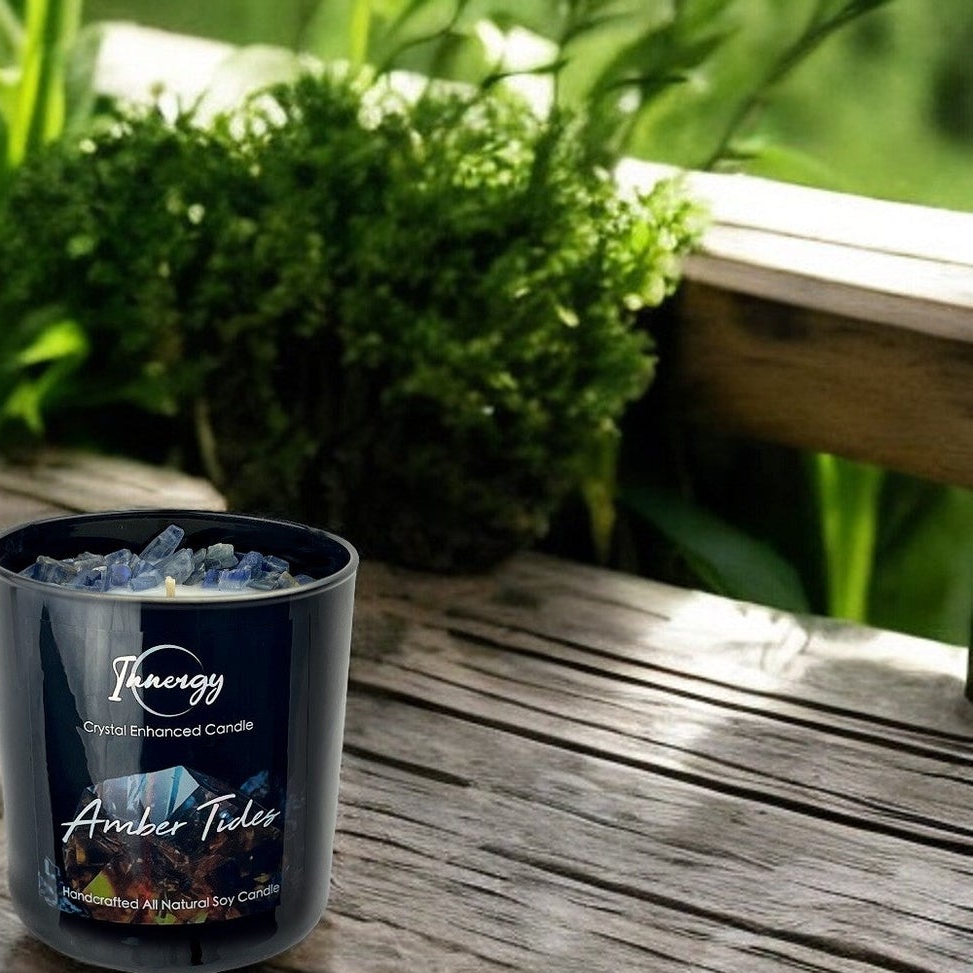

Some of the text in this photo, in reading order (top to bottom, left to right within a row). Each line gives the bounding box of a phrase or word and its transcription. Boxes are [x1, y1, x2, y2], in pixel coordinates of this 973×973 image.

[107, 655, 224, 706] Innergy
[83, 719, 254, 738] Crystal Enhanced Candle
[61, 794, 281, 843] Amber Tides
[62, 882, 281, 911] Handcrafted All Natural Soy Candle
